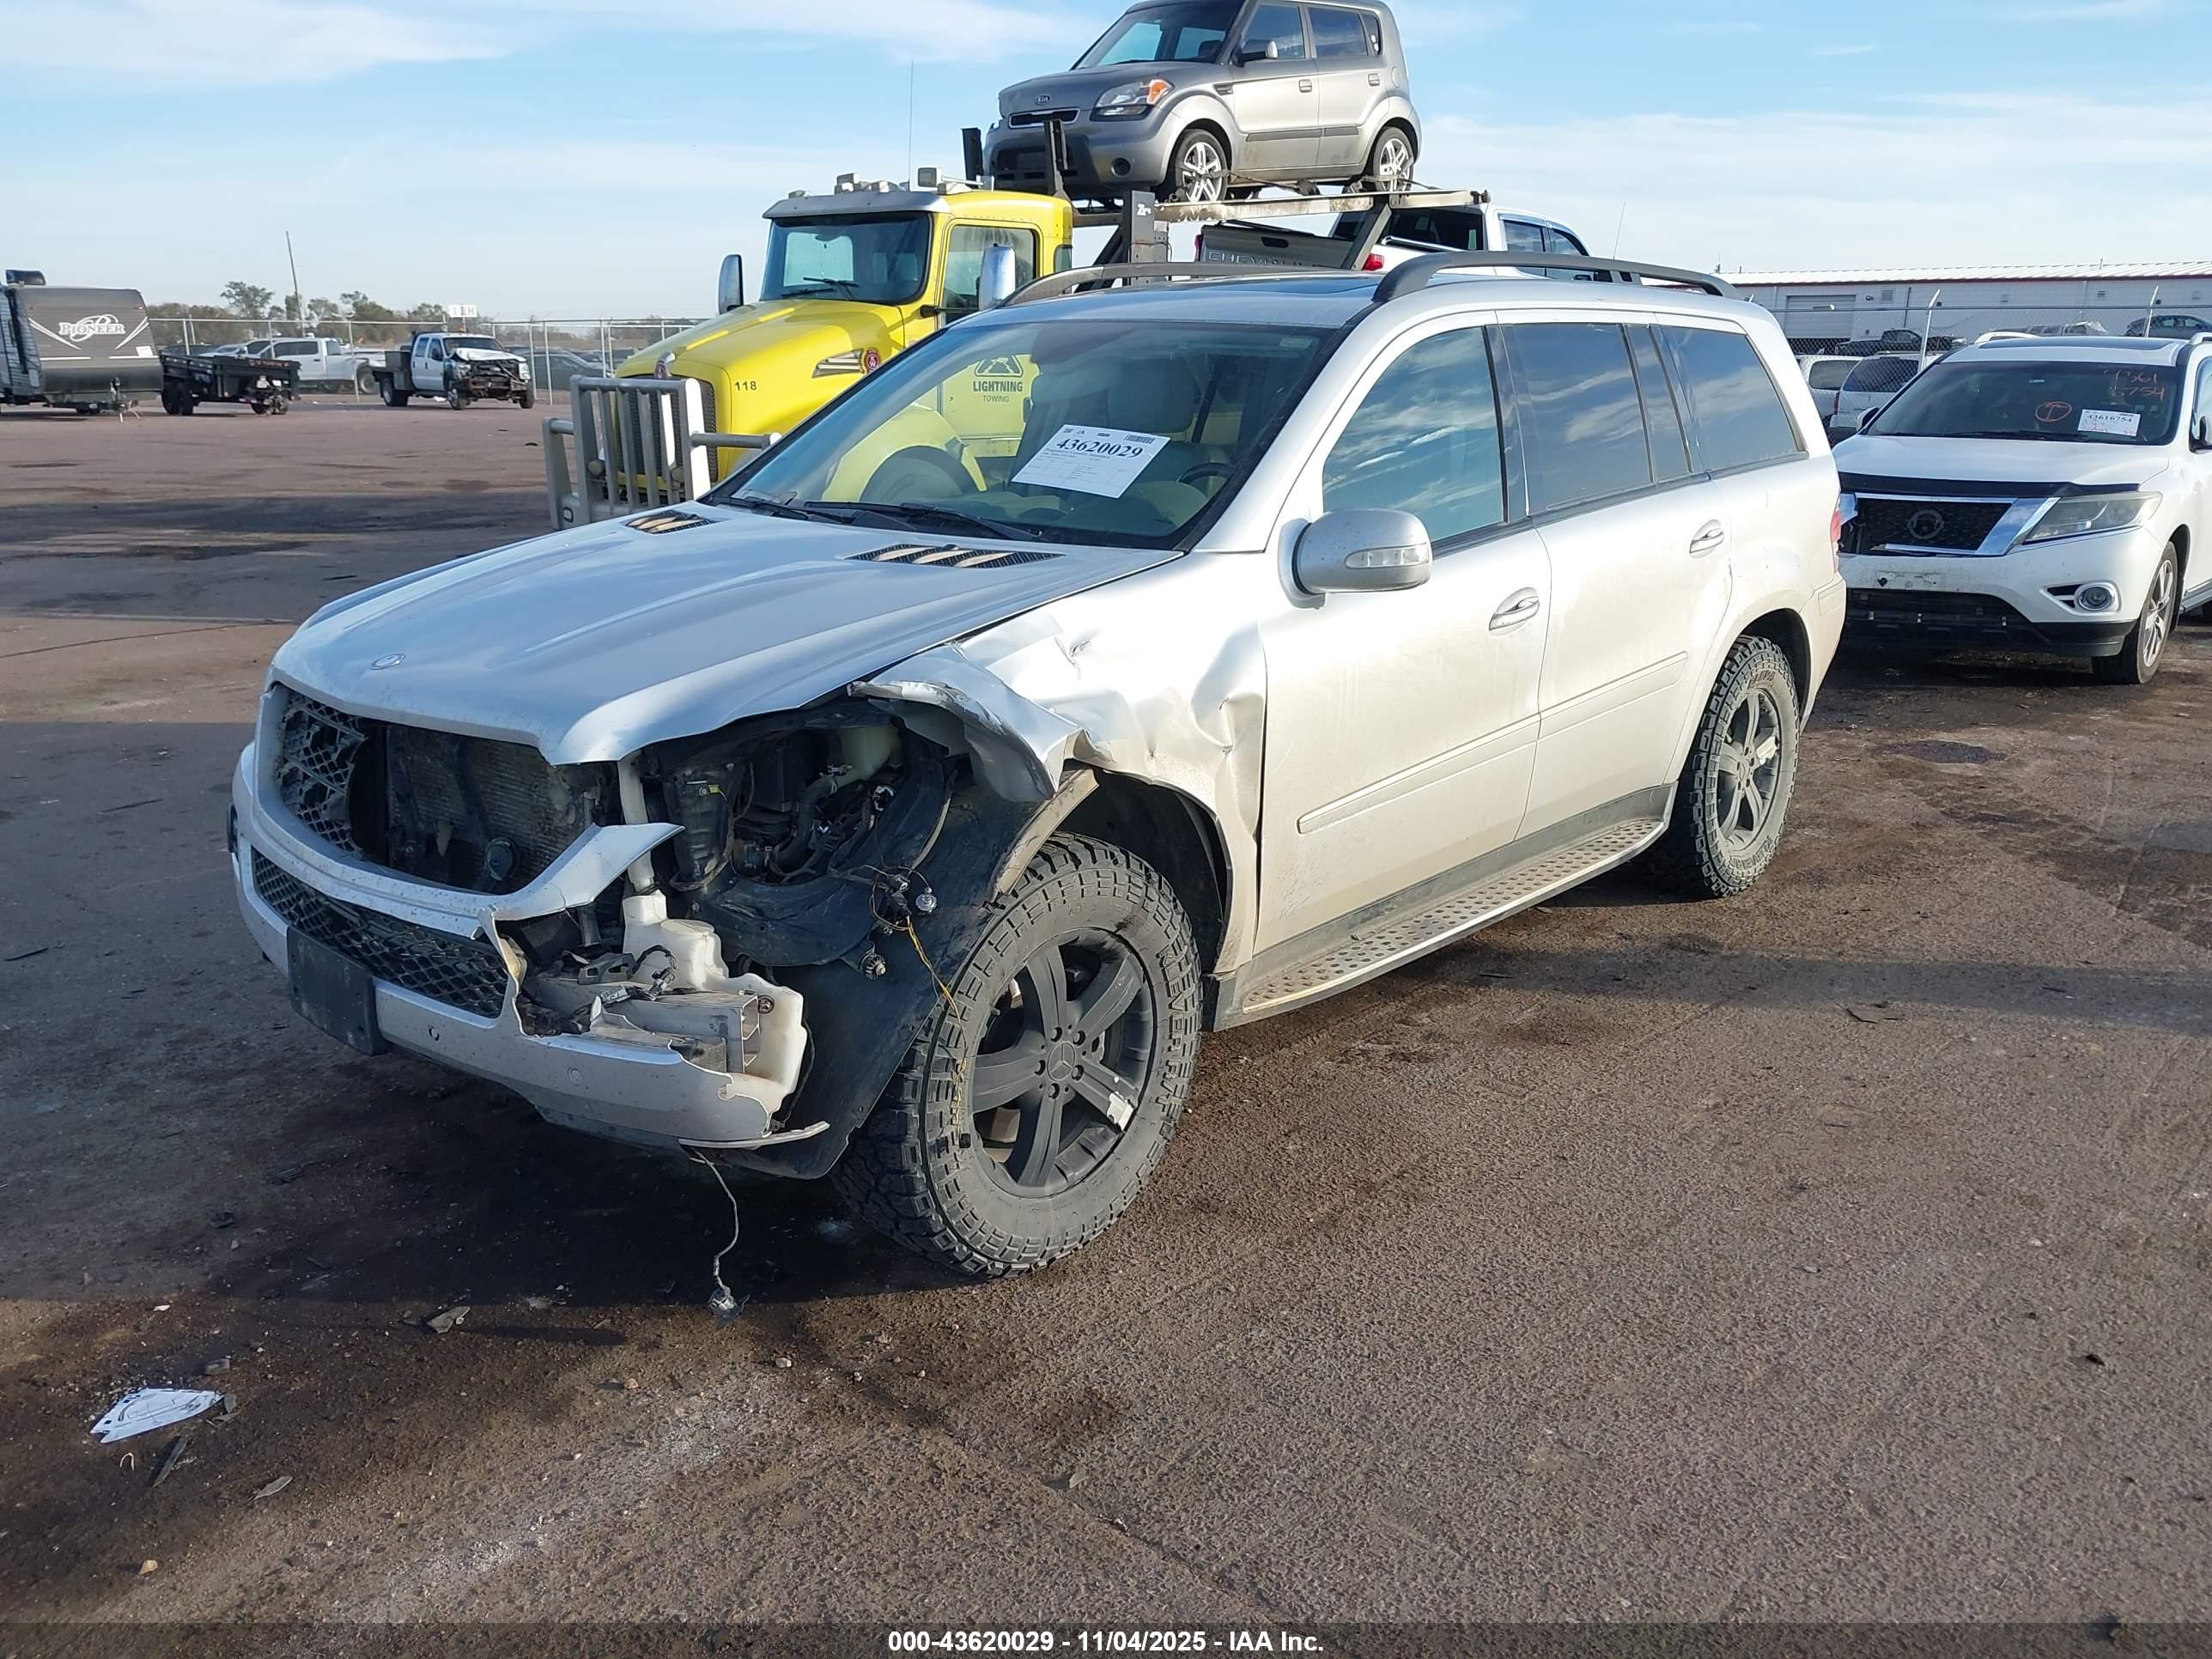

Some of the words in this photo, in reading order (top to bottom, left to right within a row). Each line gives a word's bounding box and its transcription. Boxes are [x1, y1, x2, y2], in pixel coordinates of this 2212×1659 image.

[58, 319, 126, 337] PIONEER
[734, 380, 757, 392] 118
[973, 380, 1024, 392] LIGHTNING
[1055, 438, 1144, 459] 43620029
